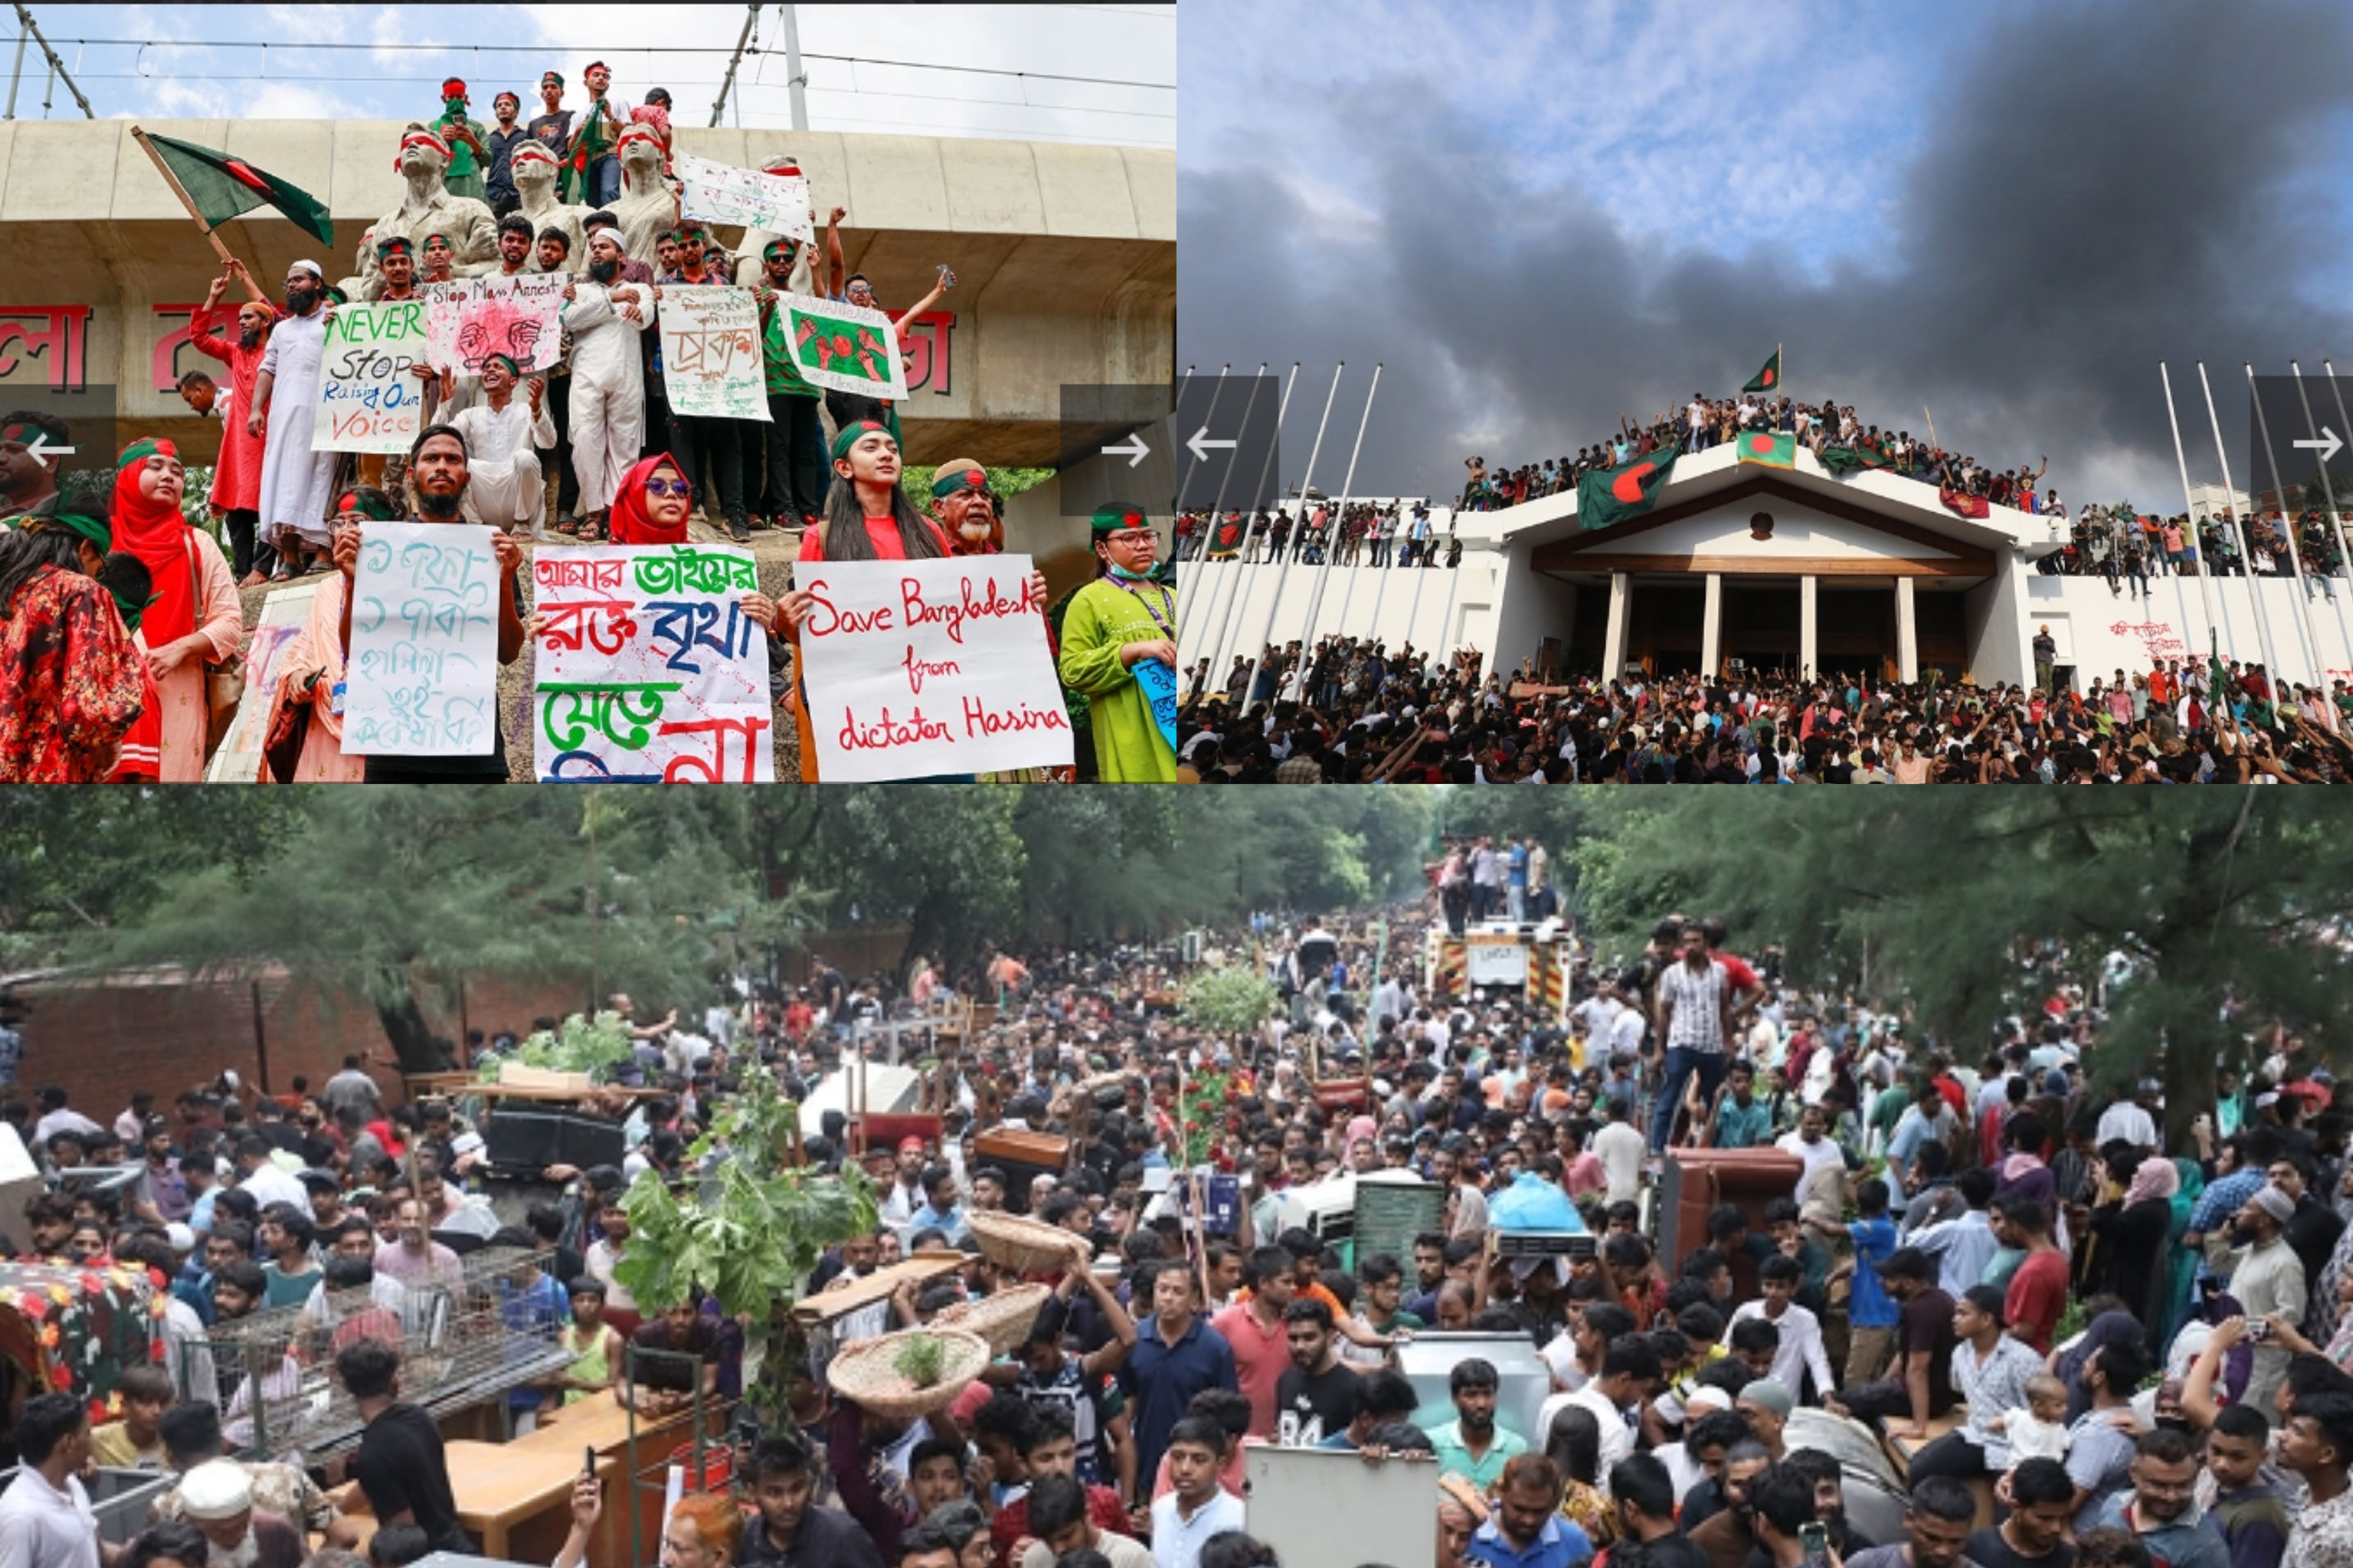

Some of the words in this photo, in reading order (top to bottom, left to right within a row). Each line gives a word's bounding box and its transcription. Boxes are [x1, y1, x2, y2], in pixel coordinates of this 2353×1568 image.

[323, 303, 426, 346] NEVER
[323, 381, 380, 409] Raising
[383, 383, 420, 409] Our
[331, 408, 415, 441] Voice
[535, 559, 627, 591] আমার
[632, 544, 757, 594] ভাইয়ের
[807, 580, 894, 637] Save
[901, 576, 1042, 644] Bangladesh
[538, 601, 637, 655] রক্ত
[642, 601, 753, 674] বৃথা
[902, 644, 961, 694] from
[536, 682, 684, 752] যেতে
[962, 695, 1069, 738] Hasina
